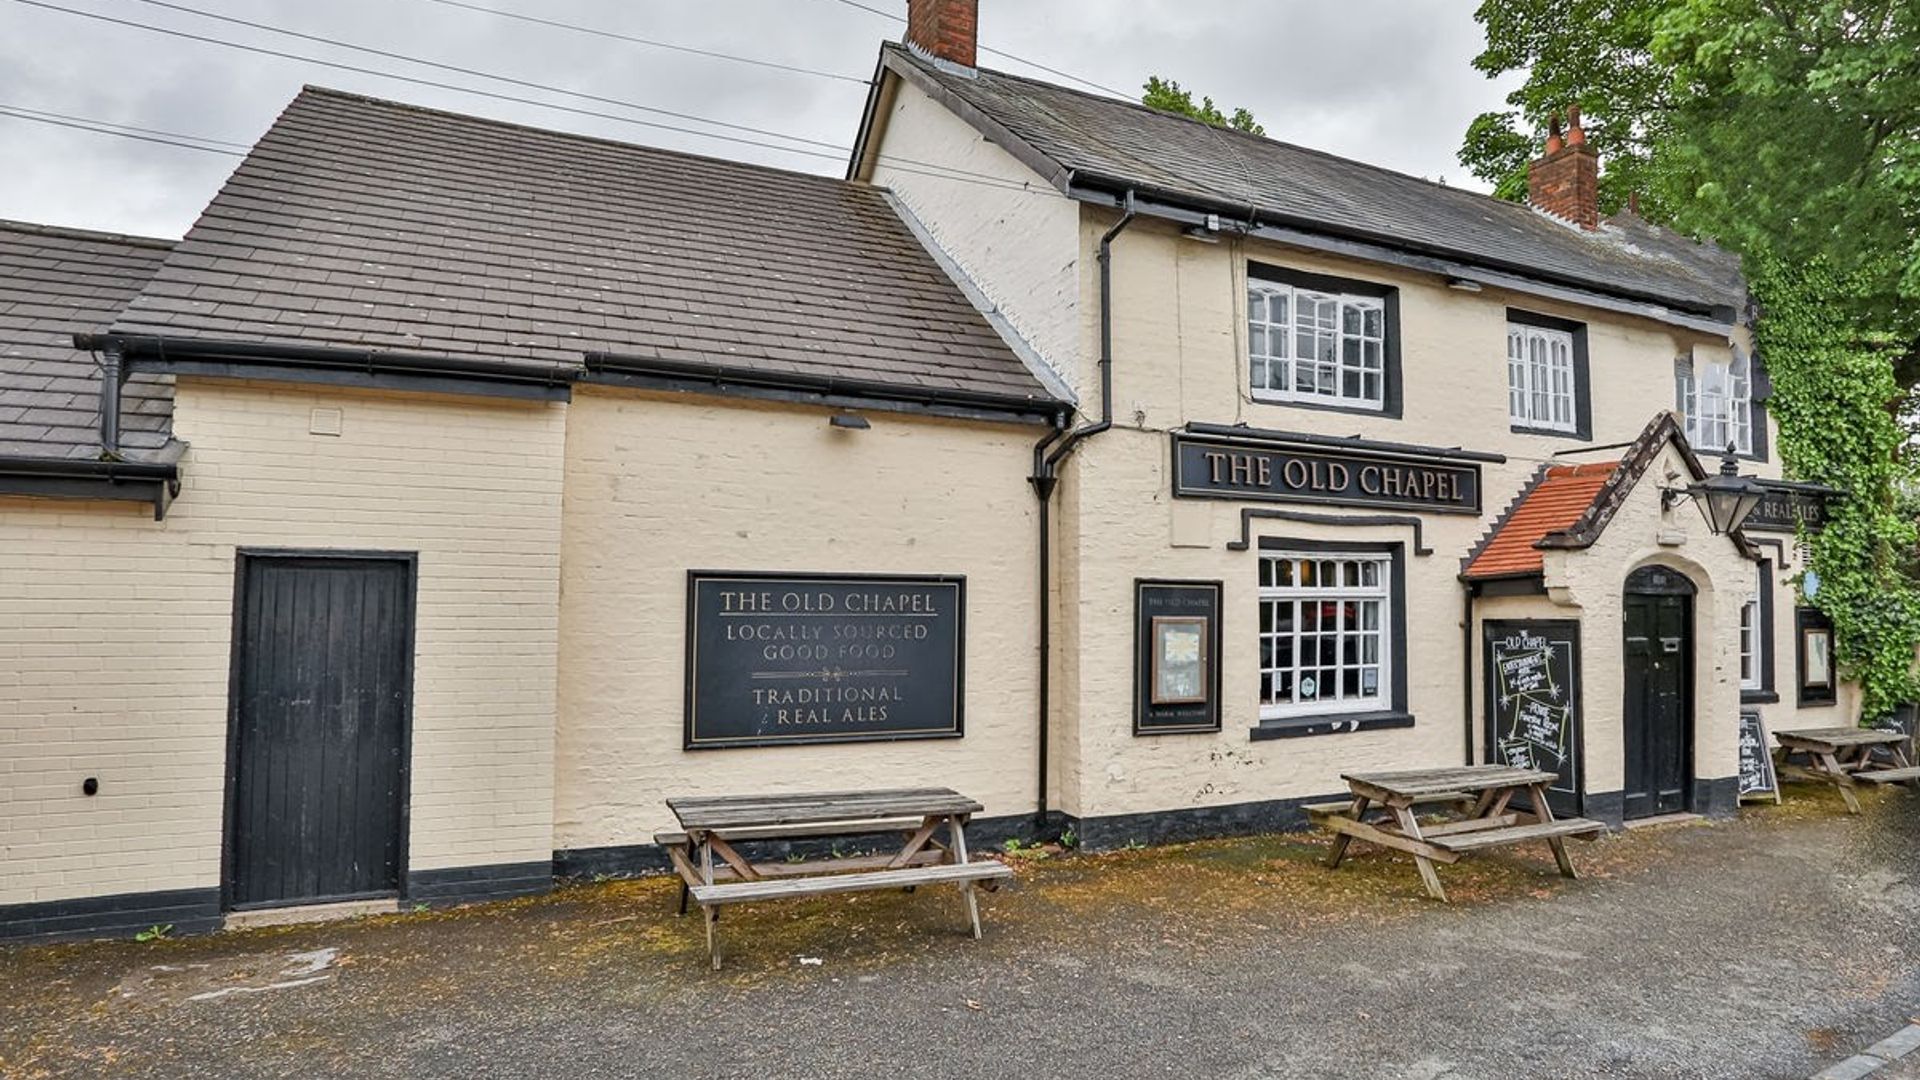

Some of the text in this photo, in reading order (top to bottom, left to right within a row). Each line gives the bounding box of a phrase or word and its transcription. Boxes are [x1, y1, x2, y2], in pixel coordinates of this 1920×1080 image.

[1205, 451, 1463, 500] THE OLD CHAPEL
[1764, 502, 1793, 519] REAL
[719, 592, 936, 613] THE OLD CHAPEL
[727, 624, 928, 641] LOCALLY SOURCED
[763, 644, 896, 660] GOOD FOOD
[752, 686, 903, 705] TRADITIONAL
[778, 706, 888, 724] REAL ALES
